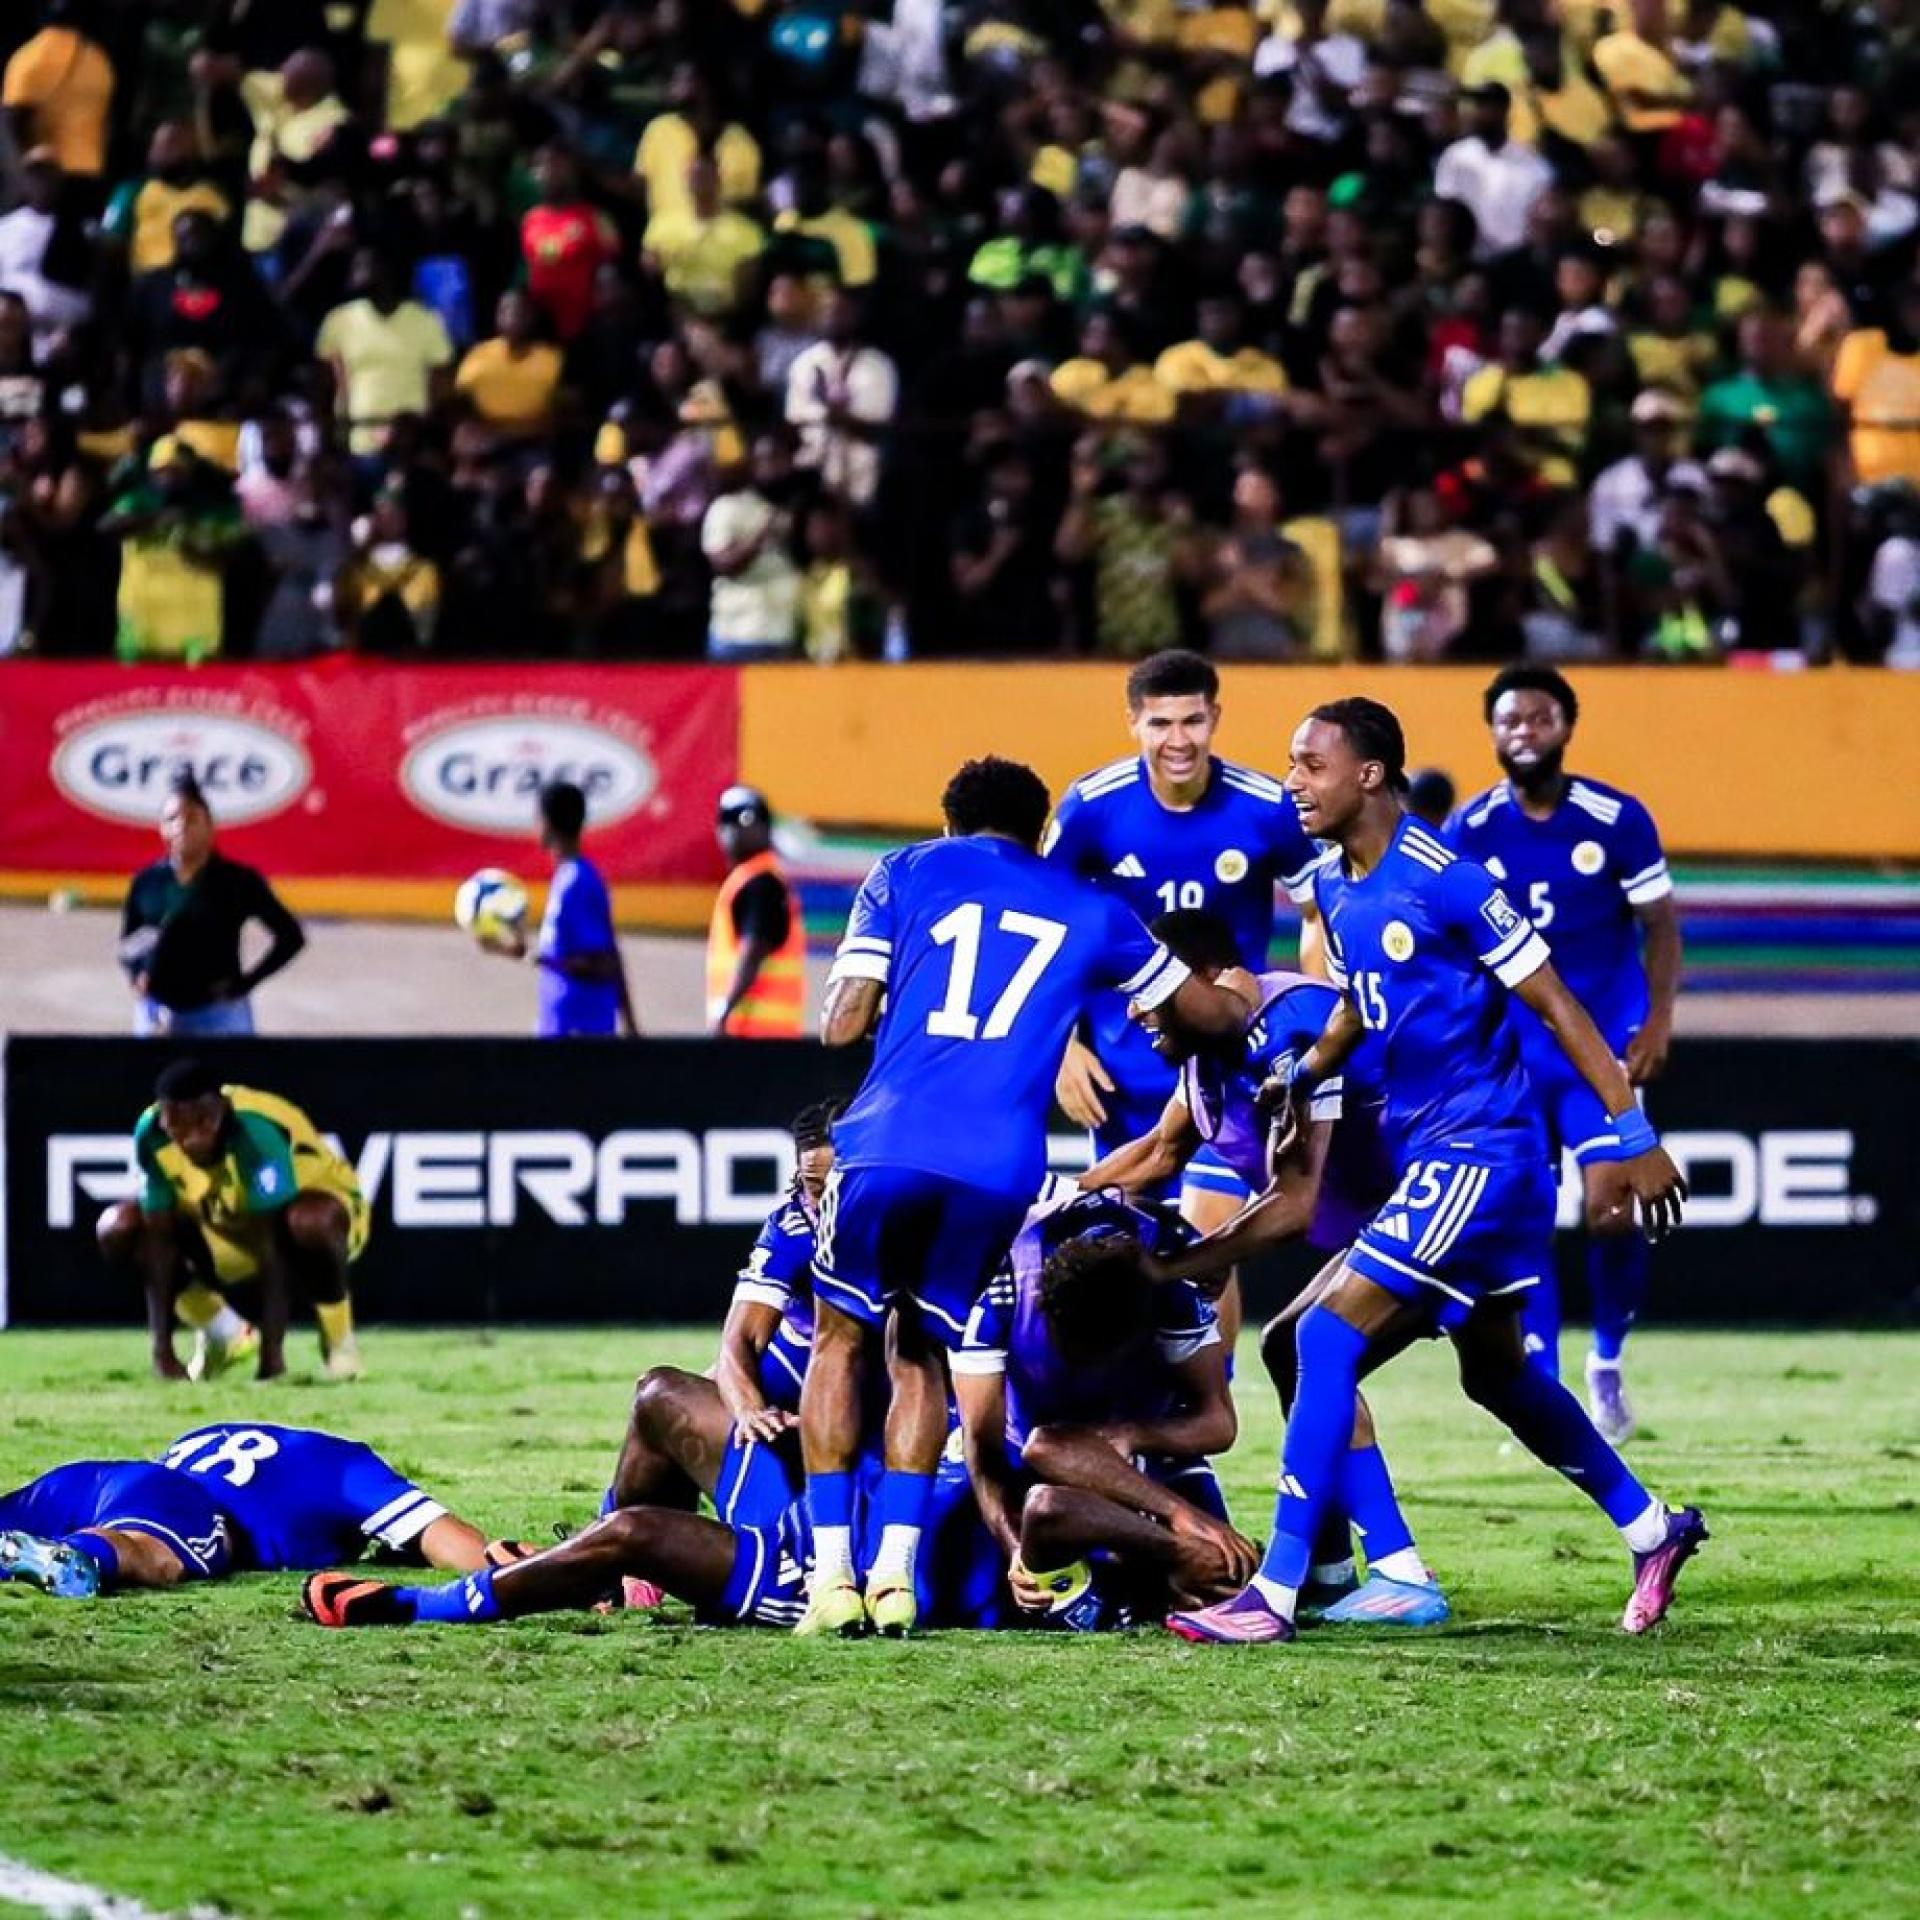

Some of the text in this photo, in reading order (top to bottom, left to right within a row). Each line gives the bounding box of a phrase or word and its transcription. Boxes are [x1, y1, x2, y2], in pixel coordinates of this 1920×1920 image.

[1529, 882, 1554, 928] 5
[926, 902, 1068, 1040] 17
[1352, 970, 1388, 1031] 15
[164, 1430, 279, 1487] 18
